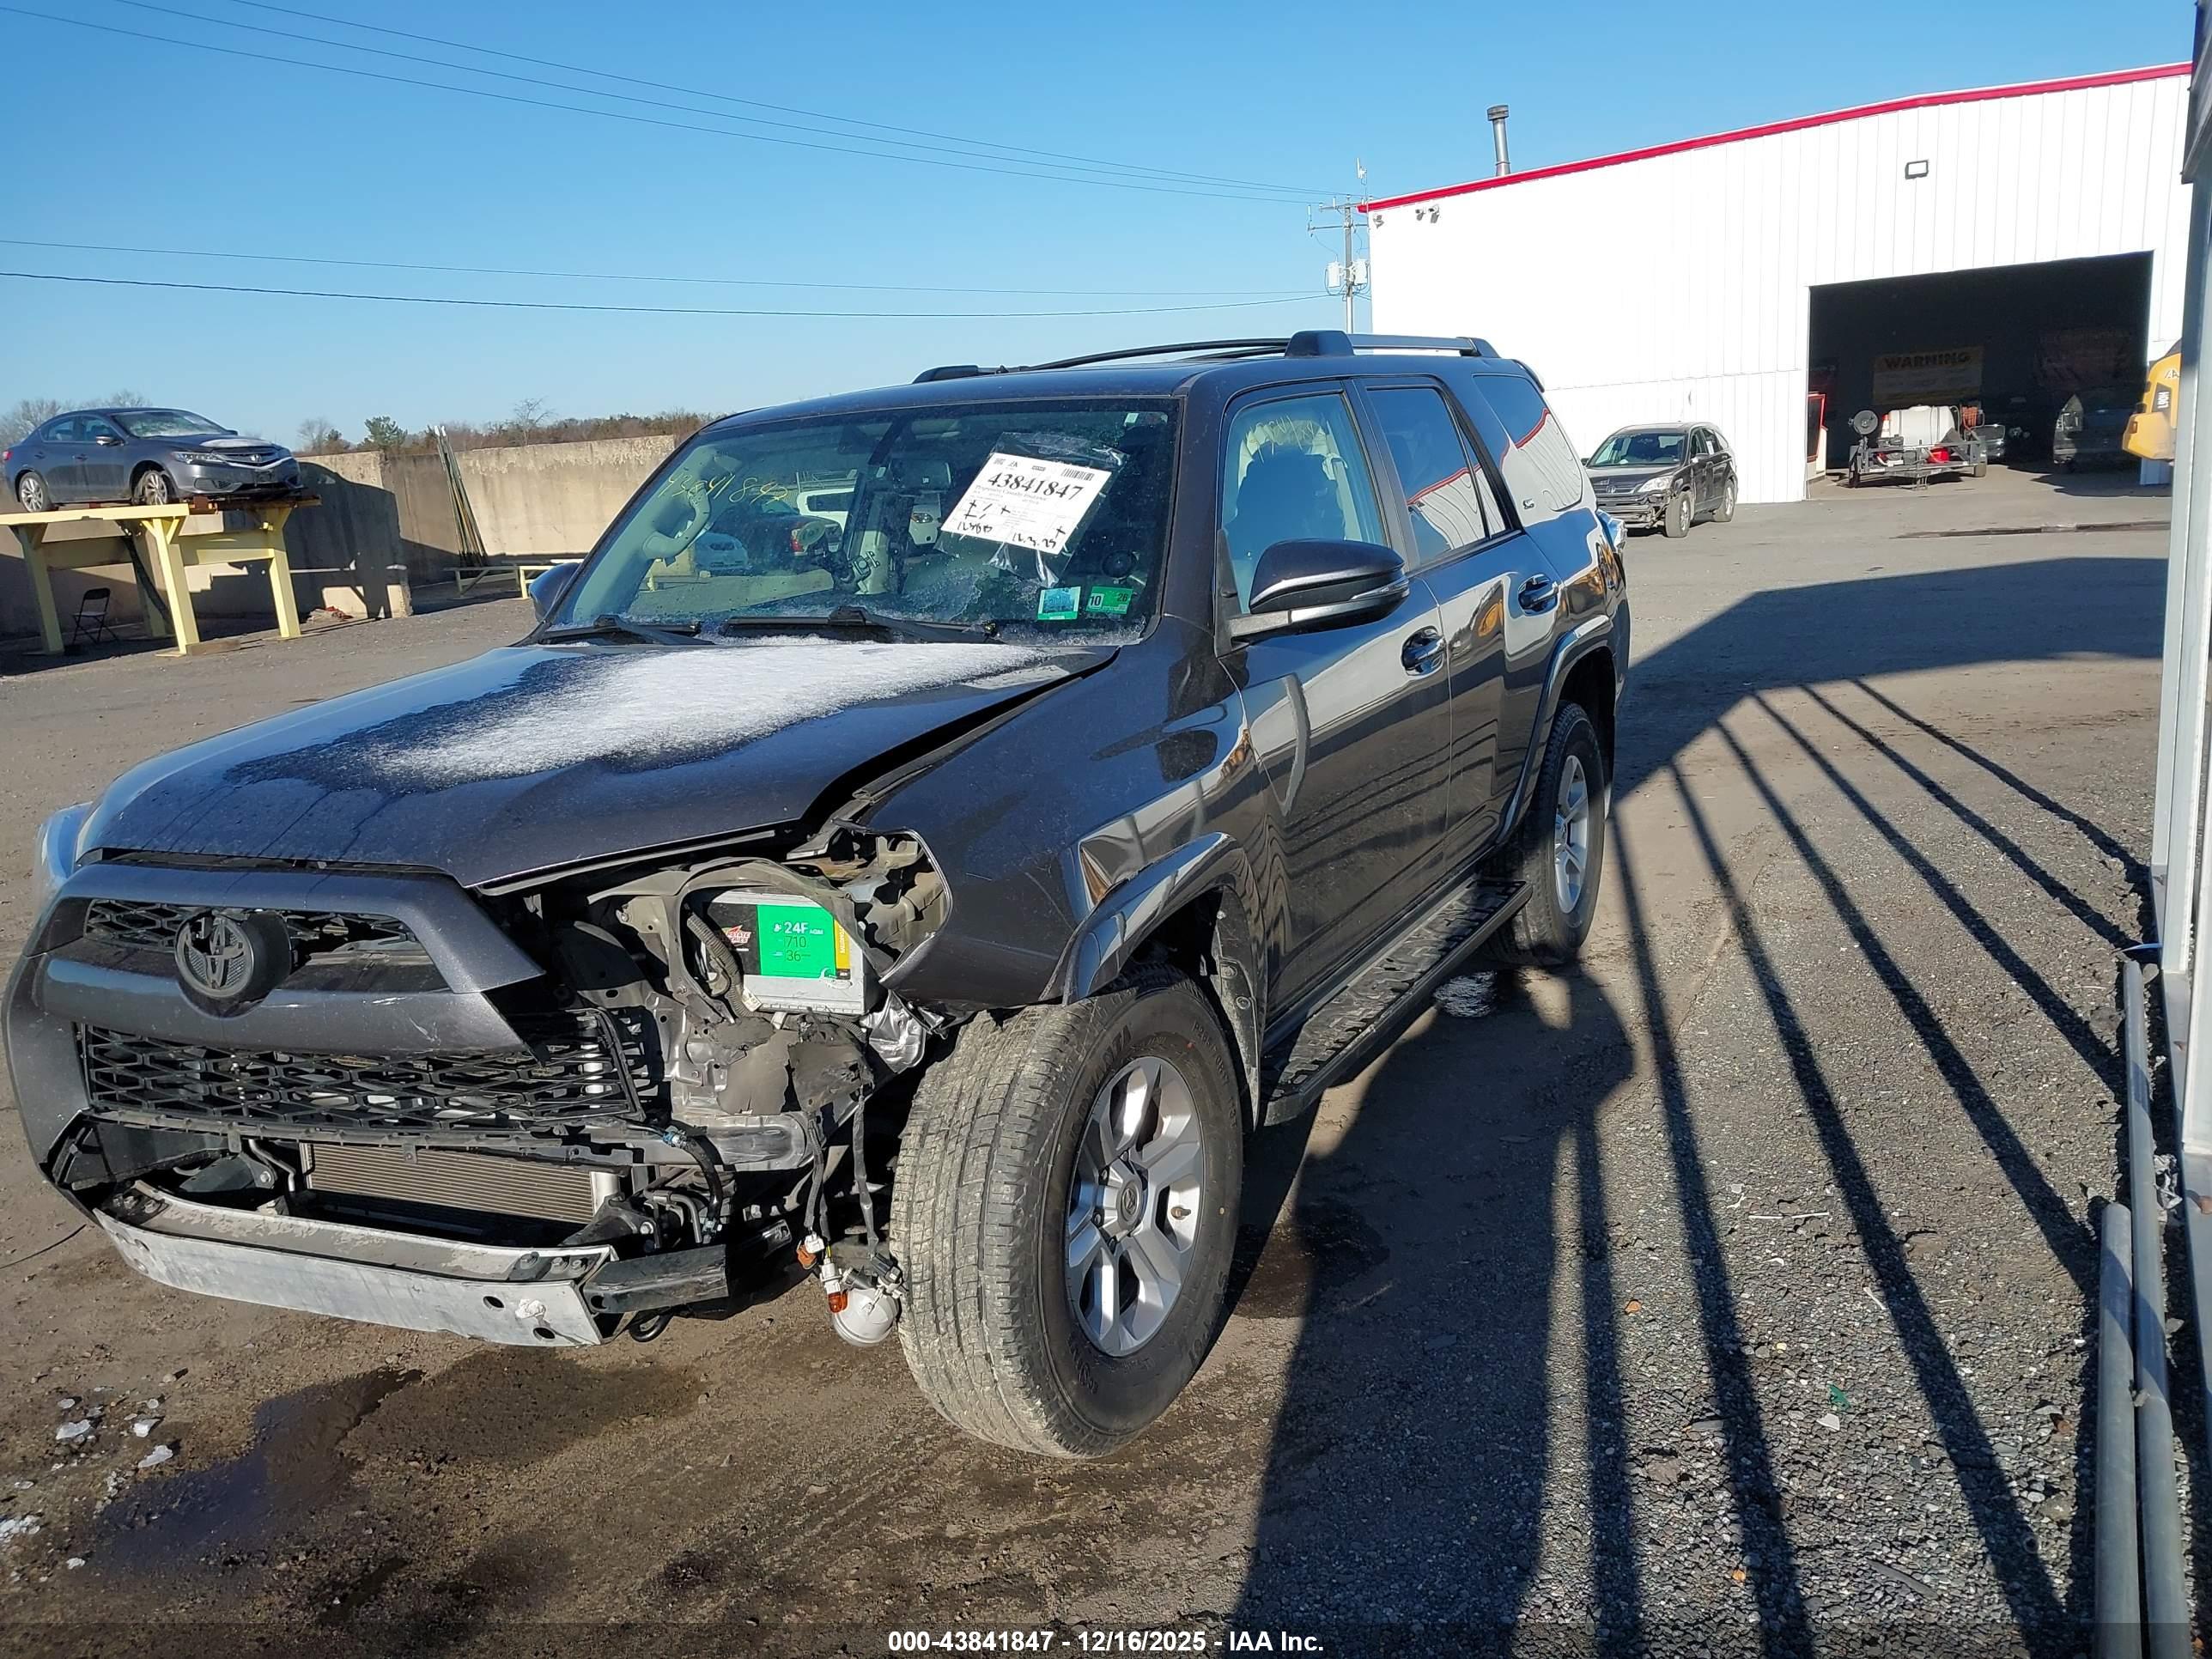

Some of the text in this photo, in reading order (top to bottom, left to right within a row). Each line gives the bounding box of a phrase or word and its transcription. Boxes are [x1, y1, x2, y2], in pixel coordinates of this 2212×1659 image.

[1885, 353, 1971, 370] WARNING
[988, 471, 1085, 501] 43841847
[1091, 595, 1102, 606] 10
[783, 921, 809, 934] 24F
[785, 935, 807, 948] 710
[786, 949, 802, 962] 36
